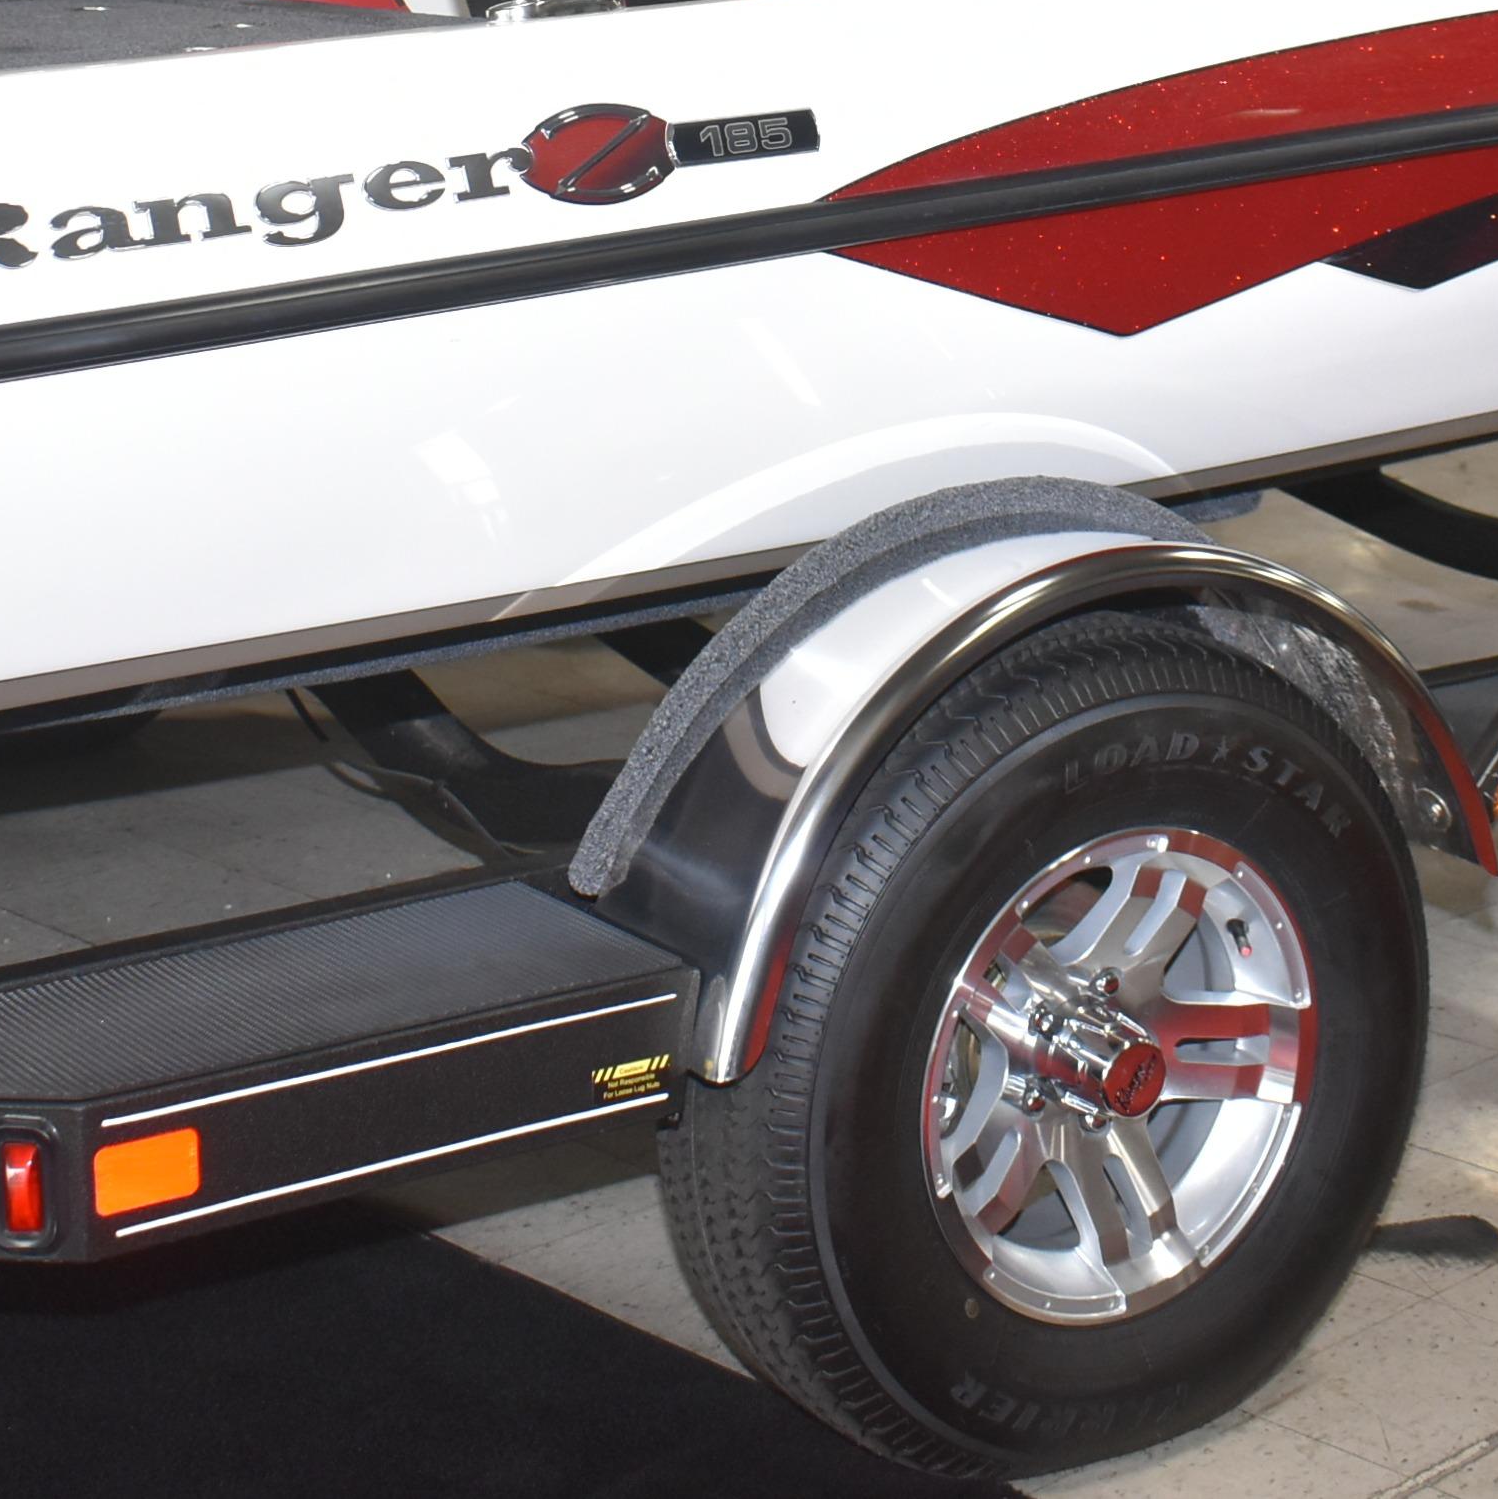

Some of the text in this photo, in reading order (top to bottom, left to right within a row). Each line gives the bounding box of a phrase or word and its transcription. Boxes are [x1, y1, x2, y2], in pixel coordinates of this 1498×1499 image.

[698, 117, 794, 158] 185
[1063, 731, 1352, 839] LOAD STAR
